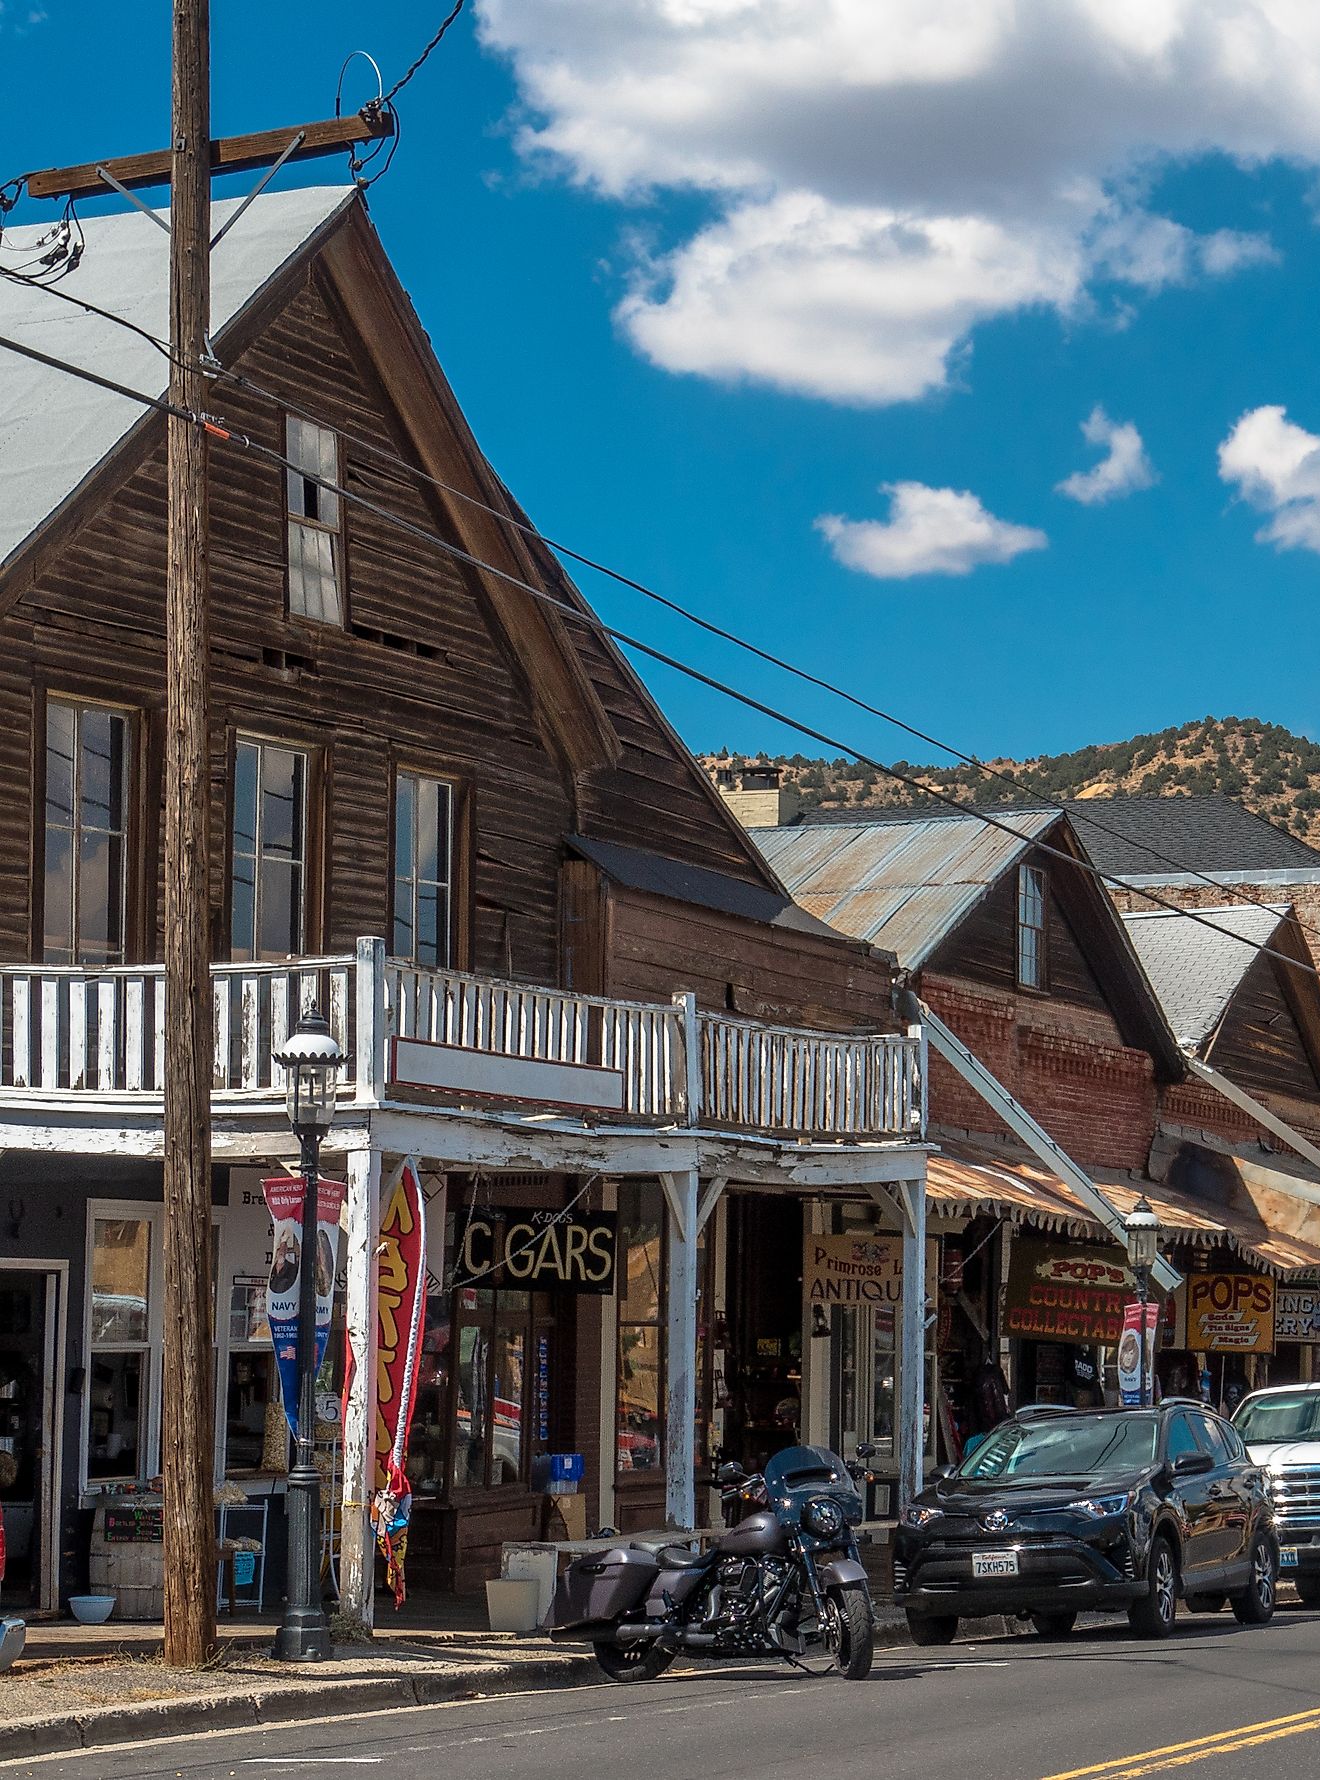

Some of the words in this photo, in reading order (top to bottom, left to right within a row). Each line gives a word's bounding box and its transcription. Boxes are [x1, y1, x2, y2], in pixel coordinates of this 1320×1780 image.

[531, 1211, 574, 1224] K-DOGS
[815, 1247, 882, 1276] Primrose
[1051, 1261, 1125, 1283] POP'S
[810, 1279, 903, 1301] ANTIQU
[1192, 1276, 1271, 1312] POPS
[271, 1302, 297, 1311] NAVY
[316, 1306, 329, 1314] RMY
[1009, 1308, 1122, 1340] COLLECTAB
[1207, 1323, 1223, 1332] Tin
[1225, 1323, 1250, 1332] Signs
[1218, 1336, 1249, 1344] Magic
[976, 1561, 1015, 1573] 7SKH575
